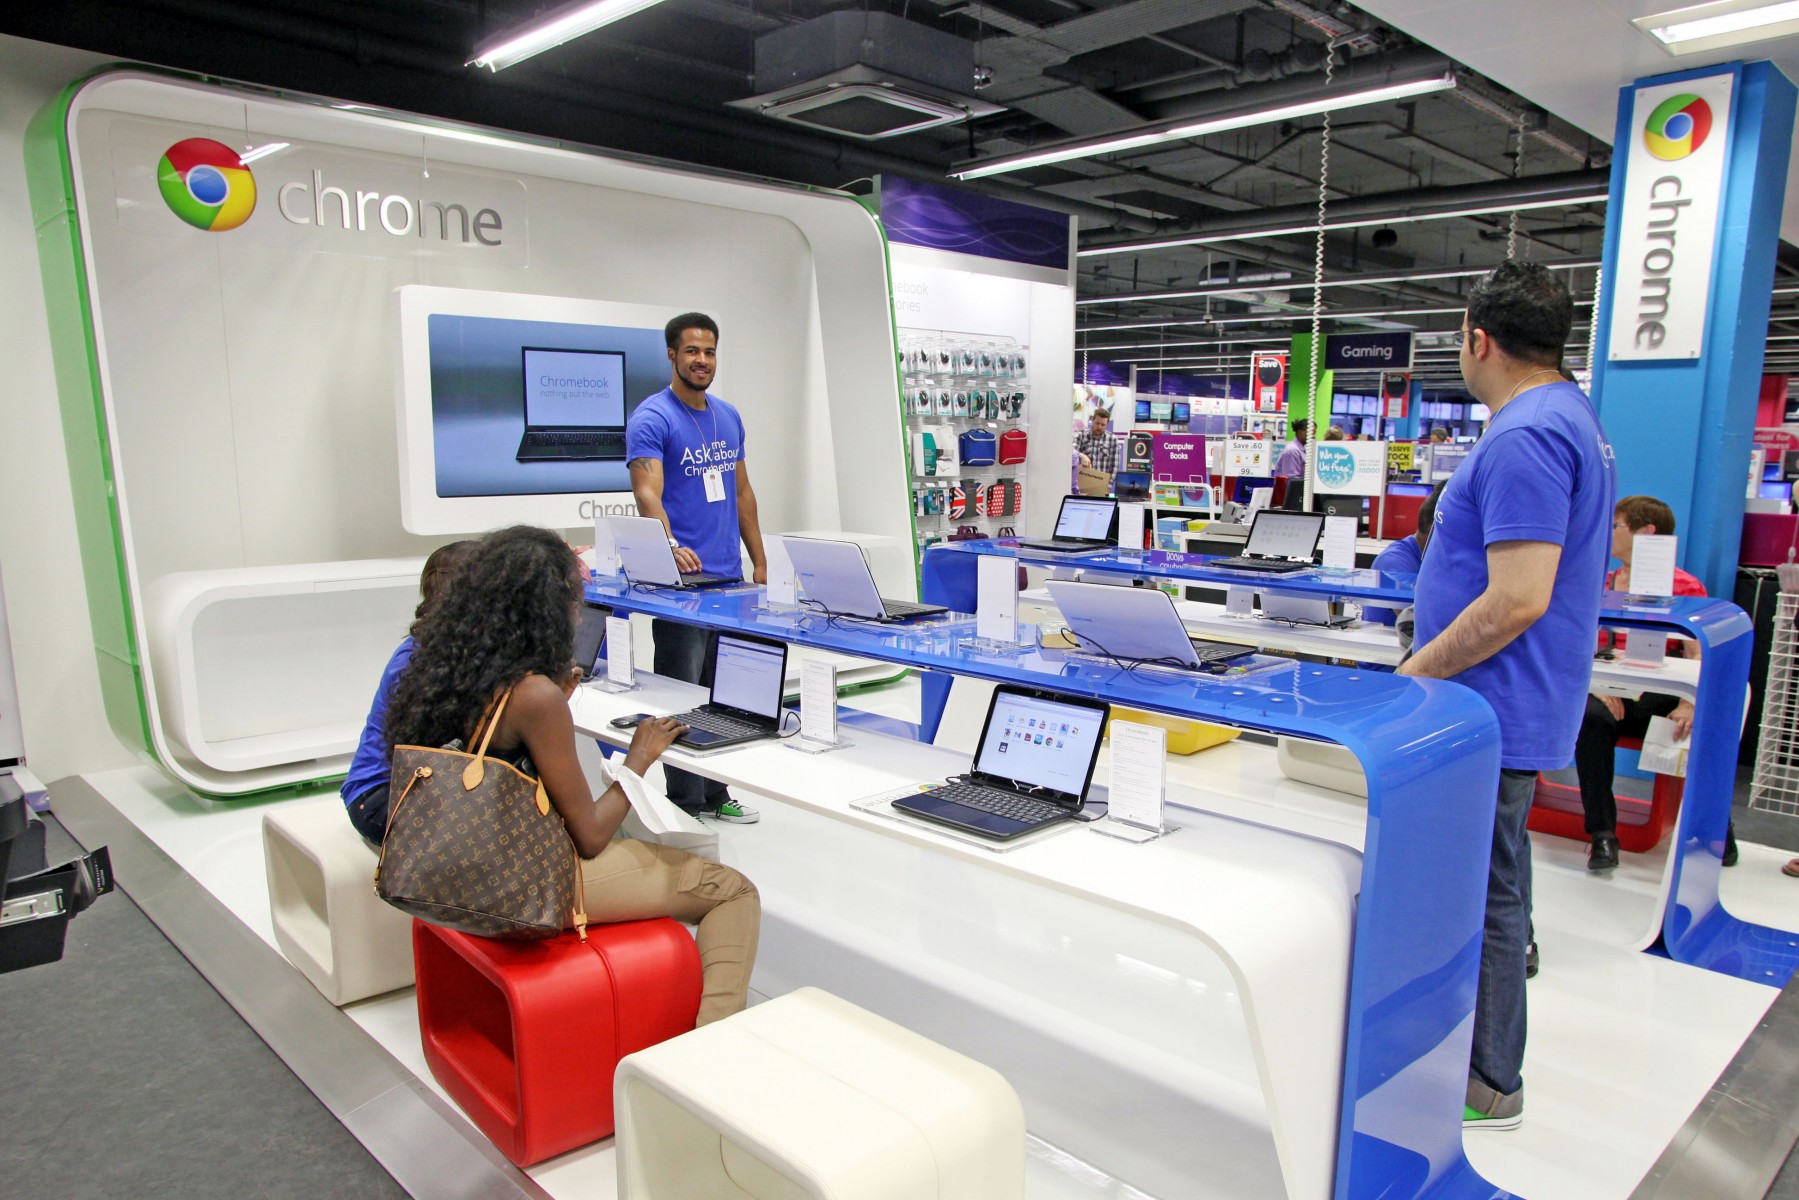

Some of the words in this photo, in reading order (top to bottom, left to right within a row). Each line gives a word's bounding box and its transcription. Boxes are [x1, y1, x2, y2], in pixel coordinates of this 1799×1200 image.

[278, 169, 502, 246] chrome
[1635, 175, 1692, 350] chrome
[1341, 345, 1393, 360] Gaming
[1259, 360, 1278, 368] Save
[540, 376, 609, 388] Chromebook
[540, 390, 568, 399] nothing
[680, 444, 712, 465] Ask
[711, 440, 726, 450] me
[1164, 443, 1194, 452] Computer
[1320, 449, 1332, 459] Win
[1334, 452, 1350, 463] your
[579, 500, 638, 519] Chrom
